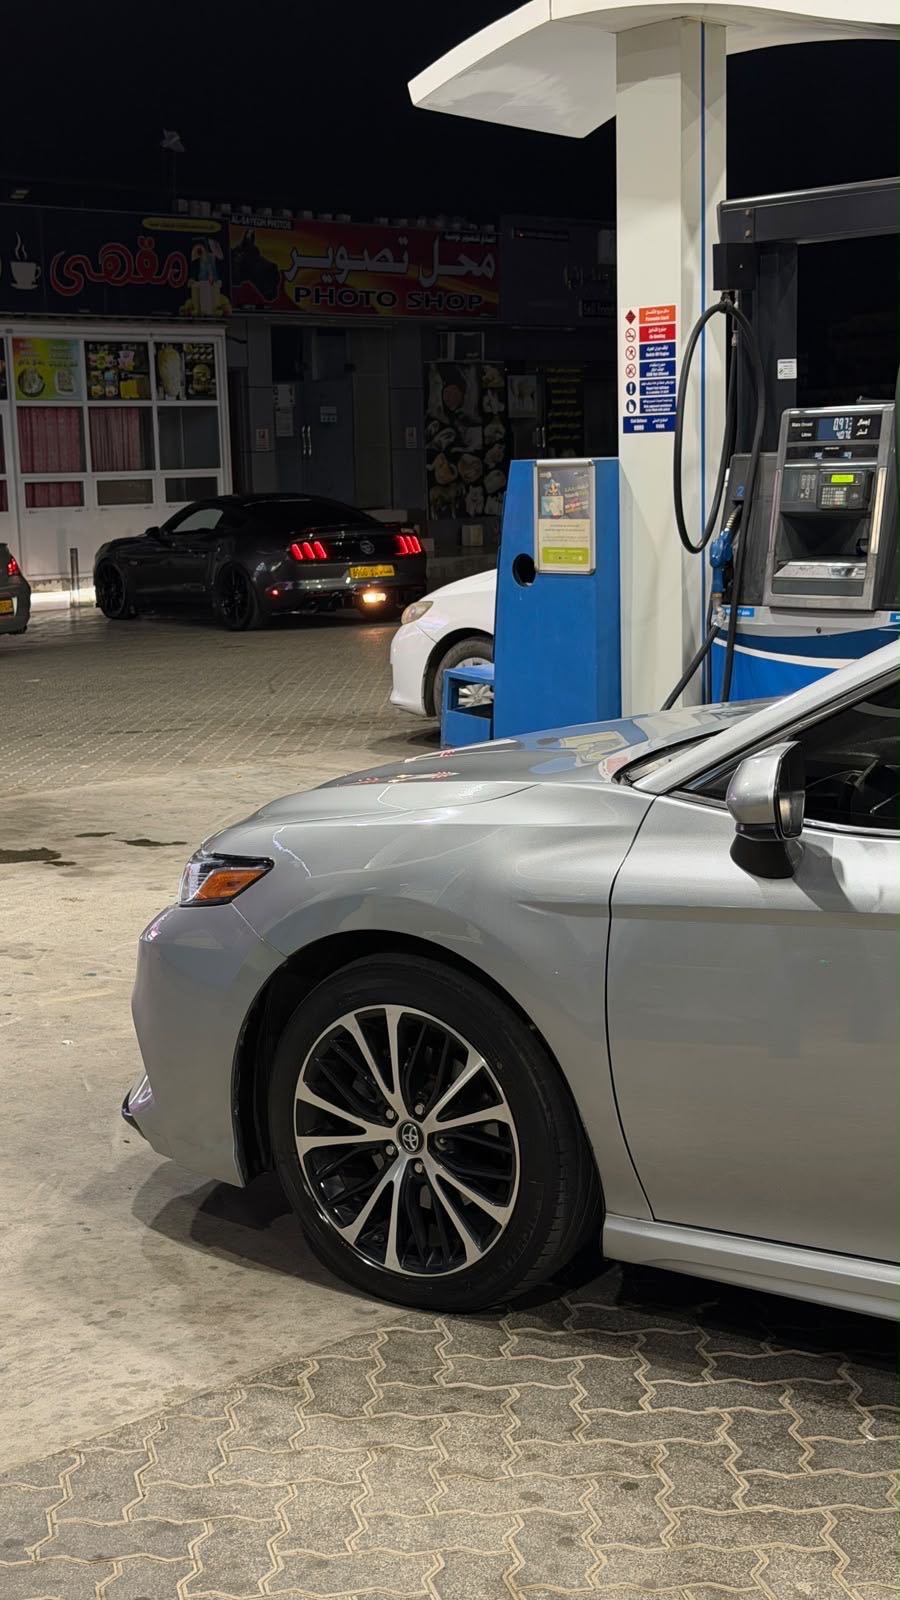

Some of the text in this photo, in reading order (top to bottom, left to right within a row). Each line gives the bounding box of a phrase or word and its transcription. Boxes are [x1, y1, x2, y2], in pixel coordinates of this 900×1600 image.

[50, 235, 188, 297] مقهى
[284, 234, 496, 288] محل تصوير
[294, 287, 484, 311] PHOTO SHOP
